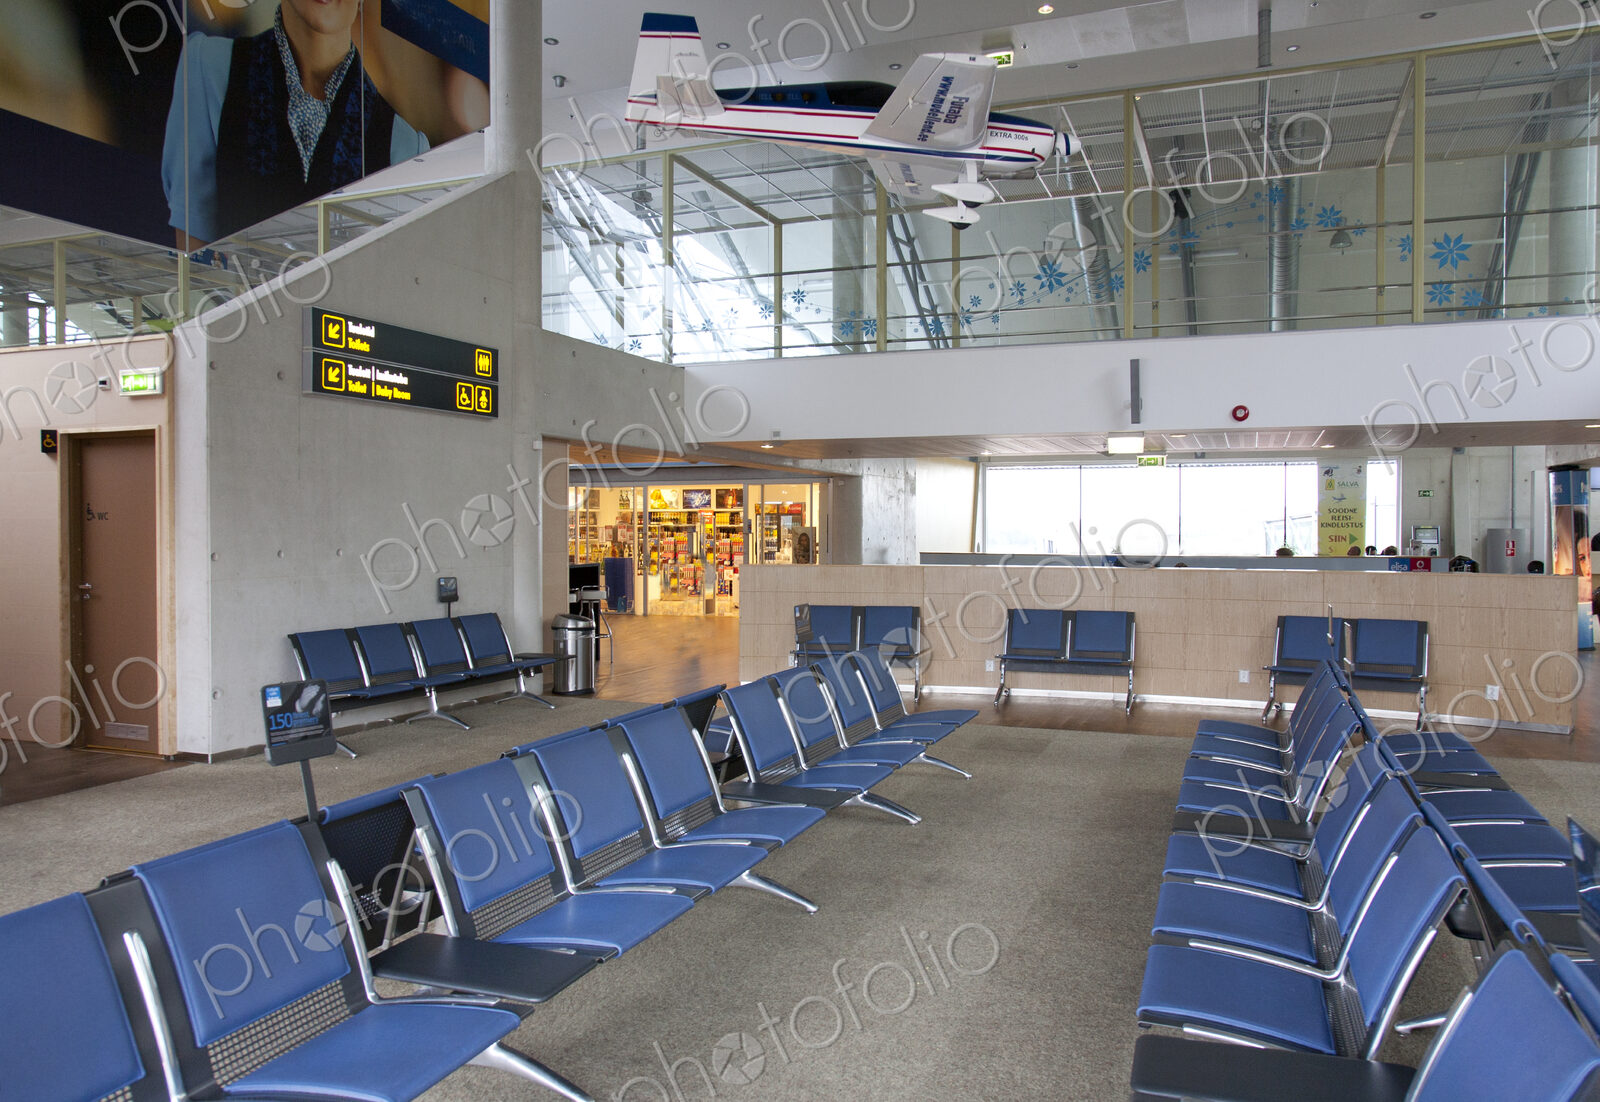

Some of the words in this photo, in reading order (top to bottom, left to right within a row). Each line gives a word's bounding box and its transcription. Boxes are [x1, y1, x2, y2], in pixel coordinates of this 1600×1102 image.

[943, 96, 969, 124] Futaba
[990, 130, 1012, 139] EXTRA
[1013, 133, 1029, 141] 300s
[347, 336, 370, 352] Toilets
[1337, 480, 1359, 488] SALVA
[97, 511, 109, 521] WC
[1320, 521, 1364, 529] KINDLUSTUS
[1390, 561, 1408, 571] elisa
[268, 712, 293, 731] 150
